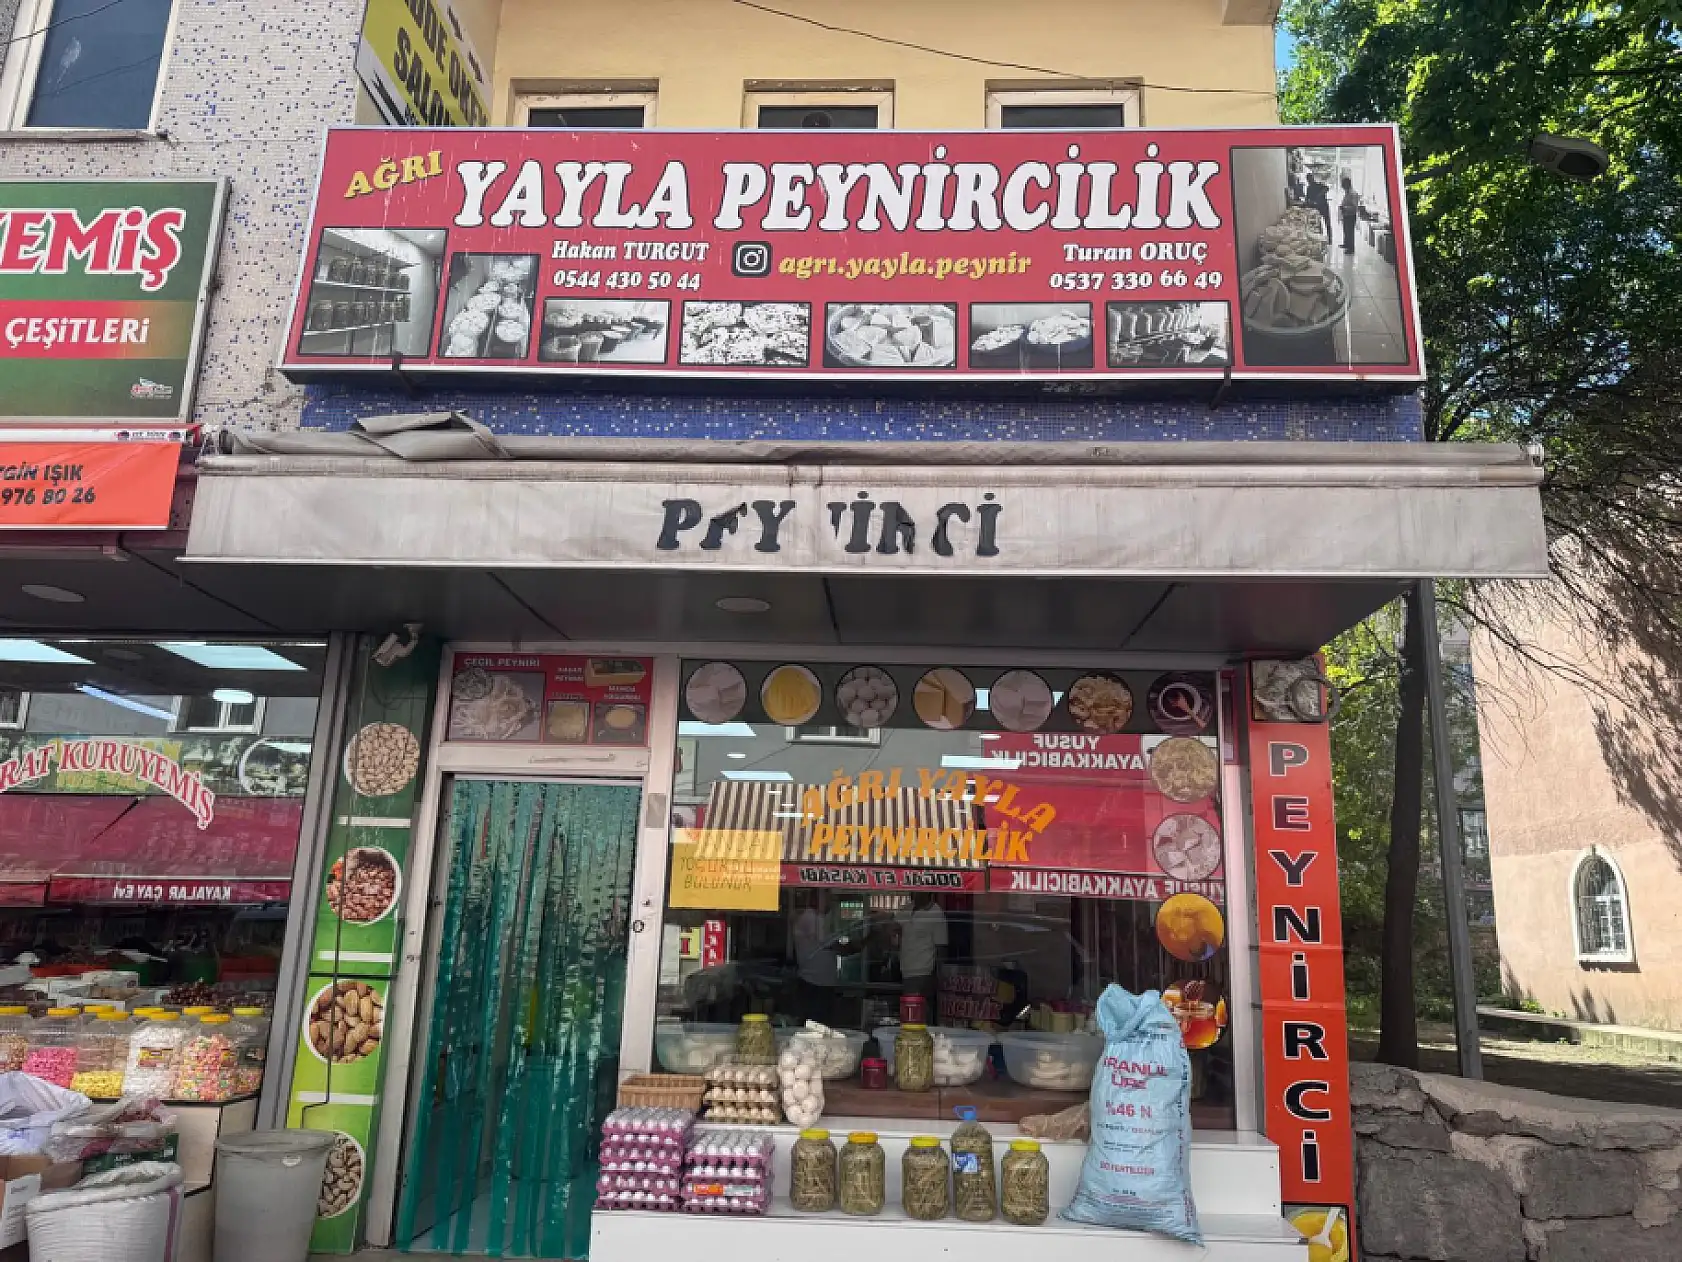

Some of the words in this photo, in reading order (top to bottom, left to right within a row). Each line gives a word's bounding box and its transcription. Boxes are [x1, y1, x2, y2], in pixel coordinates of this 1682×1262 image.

[344, 150, 444, 199] AĞRI
[453, 159, 694, 230] YAYLA
[713, 143, 1223, 232] PEYNİRCİLİK
[551, 240, 617, 260] Hakan
[623, 242, 710, 261] TURGUT
[1063, 243, 1133, 262] Turan
[1139, 242, 1208, 266] ORUÇ
[553, 270, 601, 289] 0544
[605, 271, 643, 290] 430
[647, 271, 672, 290] 50
[676, 272, 702, 291] 44
[1049, 272, 1105, 291] 0537
[1111, 271, 1153, 290] 330
[1159, 270, 1188, 288] 66
[1193, 271, 1224, 290] 49
[71, 486, 96, 504] 26
[57, 739, 215, 830] KURUYEMİŞ
[801, 767, 902, 828] AĞRI
[916, 768, 1056, 834] YAYLA
[809, 816, 1033, 862] PEYNİRCİLİK
